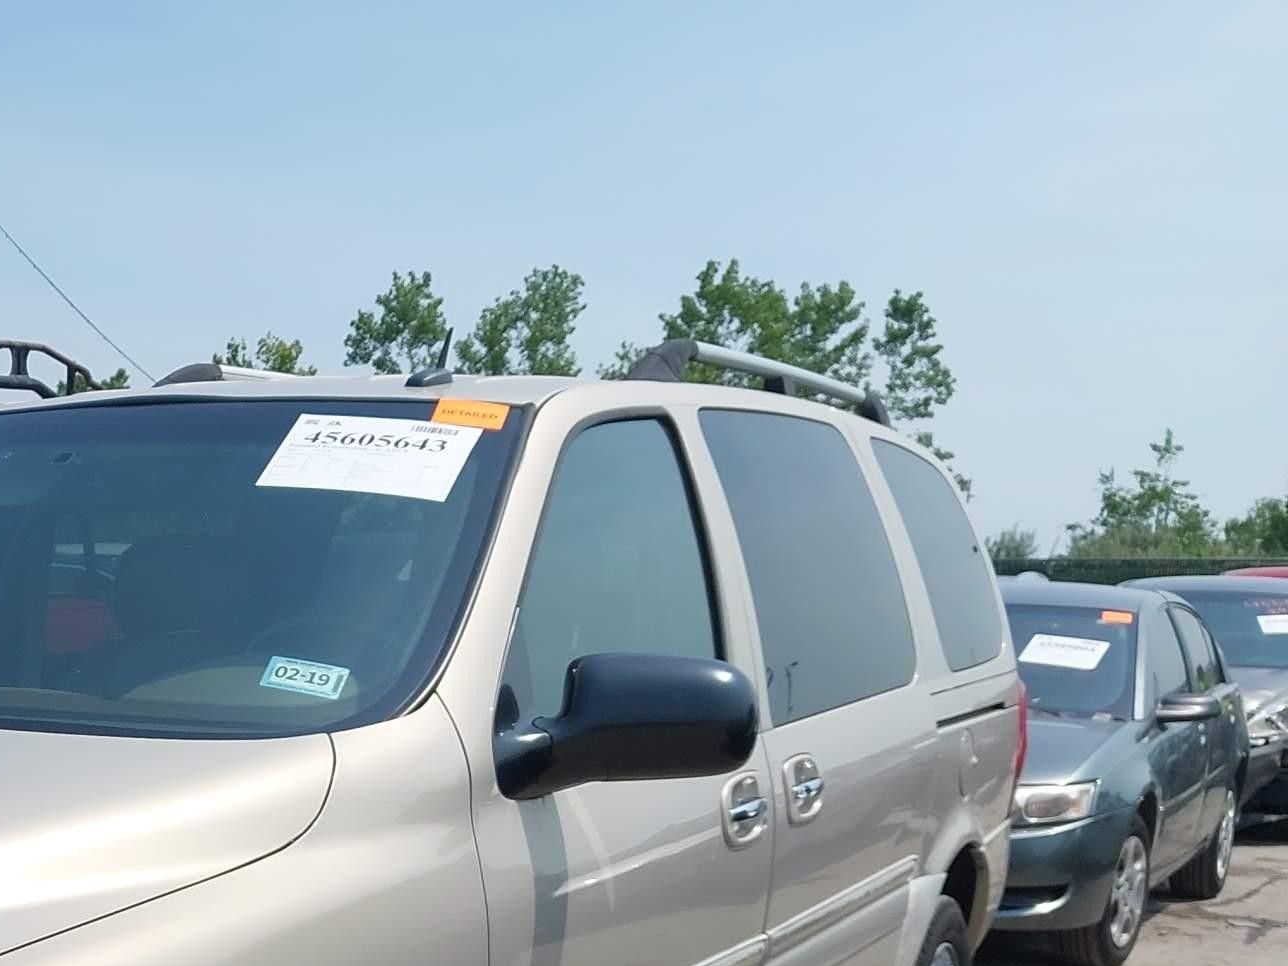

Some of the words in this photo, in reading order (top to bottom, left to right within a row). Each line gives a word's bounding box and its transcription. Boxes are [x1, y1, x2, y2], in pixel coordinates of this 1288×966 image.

[441, 408, 499, 420] DETAILED
[303, 431, 448, 453] 45605643
[274, 665, 331, 687] 02-19
